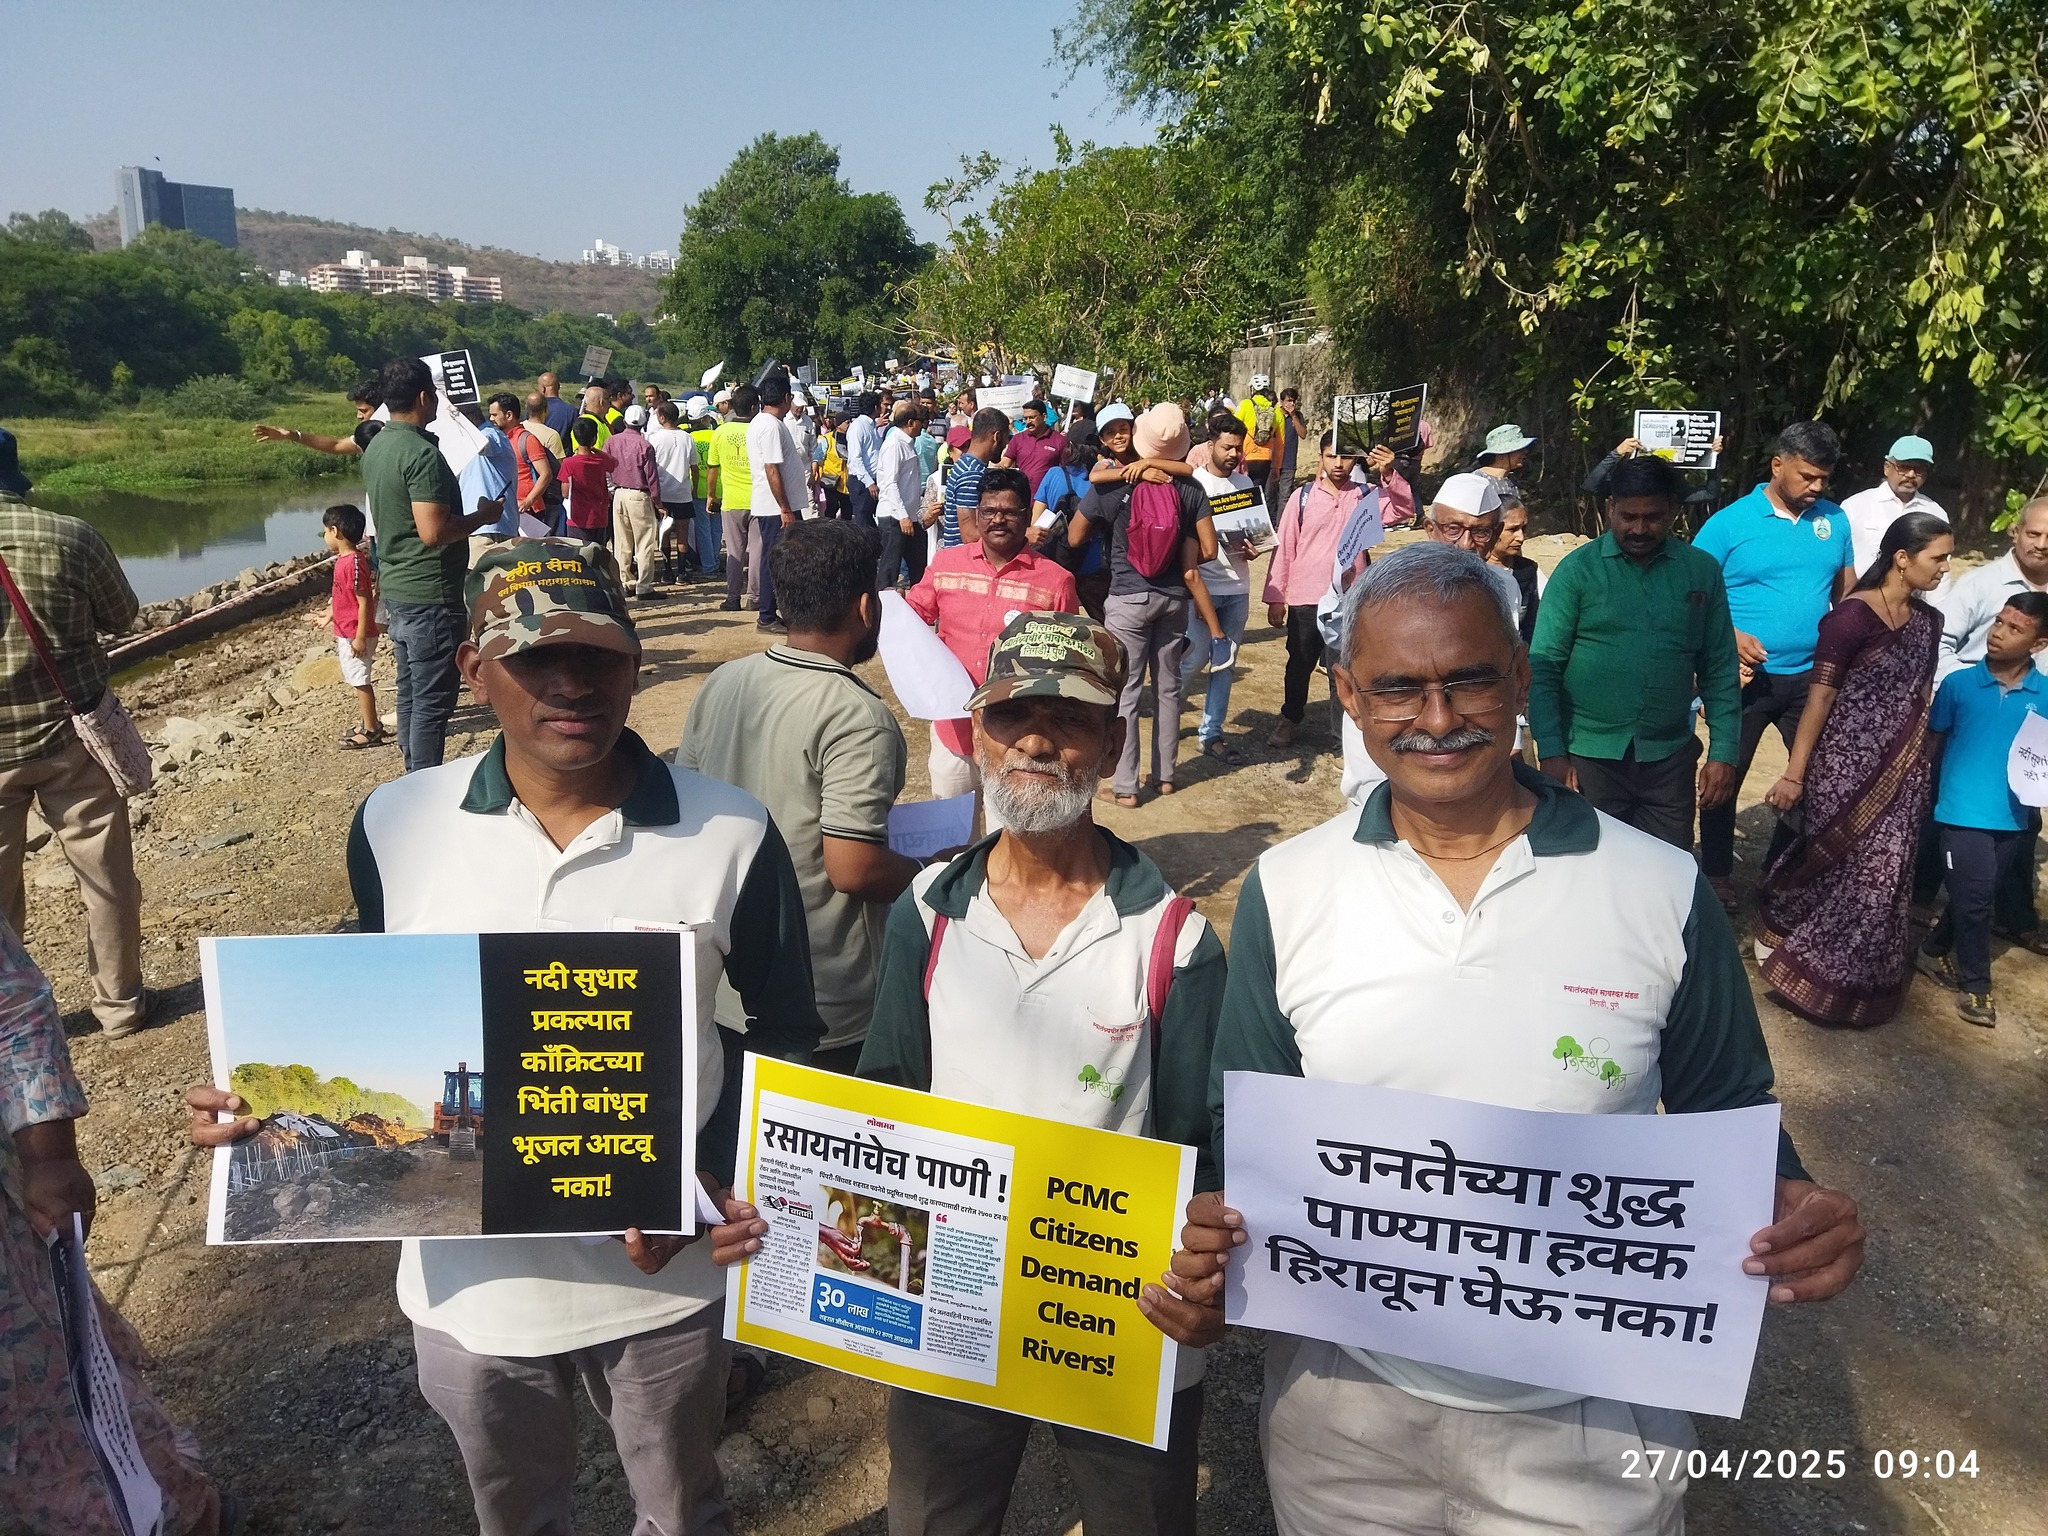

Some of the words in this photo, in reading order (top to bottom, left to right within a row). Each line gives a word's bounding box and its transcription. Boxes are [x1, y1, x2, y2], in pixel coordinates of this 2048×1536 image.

[506, 560, 542, 582] हरीत
[546, 558, 582, 573] सेना
[524, 962, 570, 991] नदी
[572, 969, 638, 997] सुधार
[531, 1010, 632, 1032] प्रकल्पात
[517, 1085, 579, 1114] भिंती
[582, 1086, 648, 1121] बांधून
[867, 1117, 895, 1130] लोकमत
[512, 1135, 582, 1165] भूजल
[586, 1134, 657, 1162] आटवू
[762, 1118, 910, 1180] रसायनांचेच
[916, 1155, 992, 1198] पाणी
[998, 1175, 1007, 1203] !
[551, 1174, 611, 1198] नका!
[904, 1192, 917, 1200] पाणी
[1046, 1176, 1129, 1214] PCMC
[1316, 1138, 1561, 1207] जनतेच्या
[1567, 1172, 1695, 1230] शुद्ध
[1029, 1216, 1139, 1258] Citizens
[1303, 1196, 1541, 1264] पाण्याचा
[1546, 1231, 1696, 1280] हक्क
[1021, 1255, 1141, 1300] Demand
[1265, 1235, 1454, 1312] हिरावून
[1459, 1265, 1569, 1325] घेऊ
[1575, 1293, 1718, 1344] नका!
[817, 1282, 846, 1312] ३०
[848, 1303, 869, 1318] लाख
[1038, 1301, 1116, 1336] Clean
[1022, 1337, 1115, 1377] Rivers!
